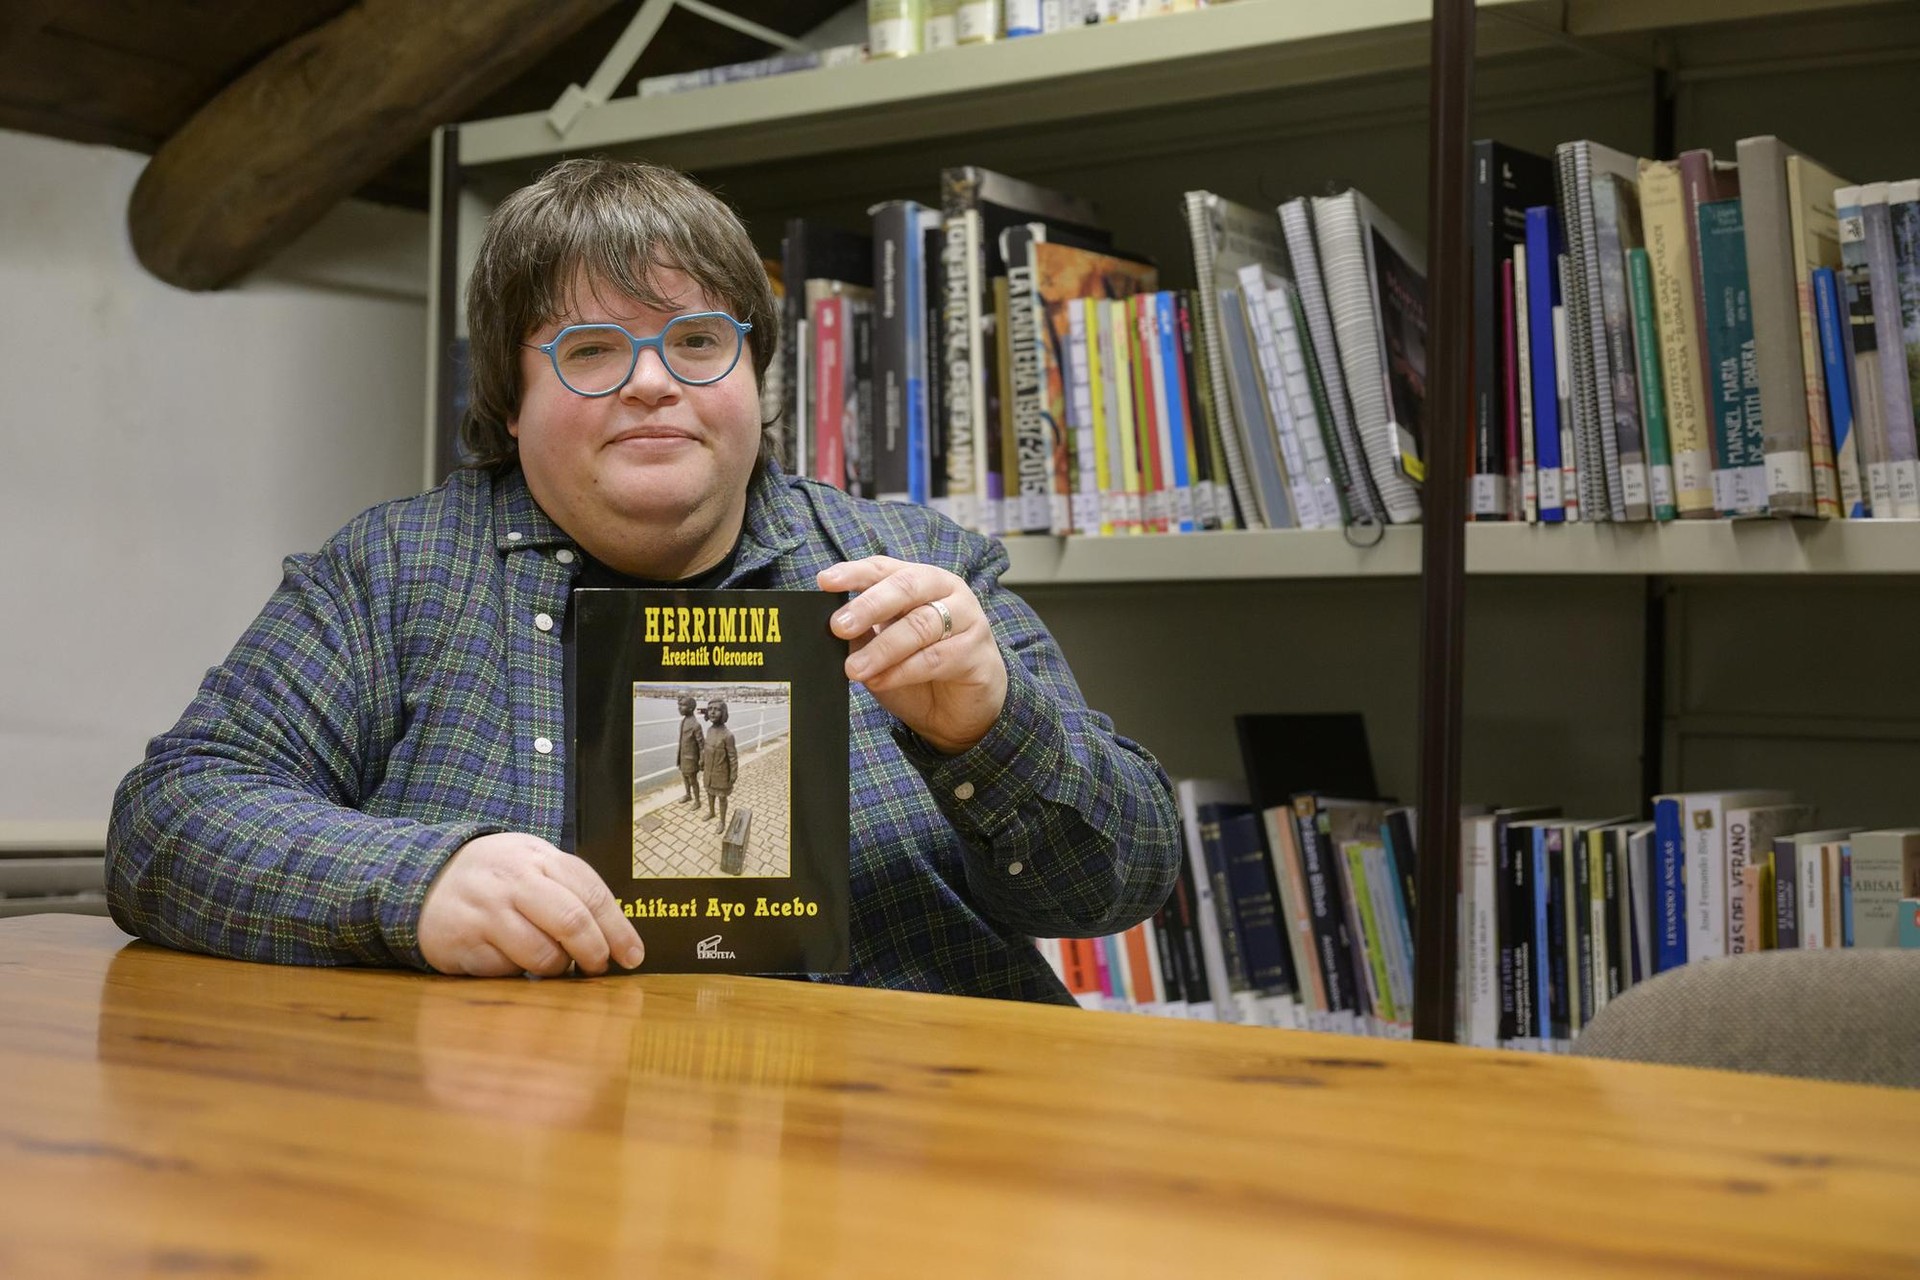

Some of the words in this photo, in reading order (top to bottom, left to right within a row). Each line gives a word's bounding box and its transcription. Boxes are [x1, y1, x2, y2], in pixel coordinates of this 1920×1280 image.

[946, 217, 971, 348] AZUMENDI
[1009, 266, 1033, 295] LA
[948, 357, 976, 495] UNIVERSO
[1724, 404, 1745, 465] MANUEL
[1744, 393, 1763, 438] SMITH
[644, 606, 782, 643] HERRIMINA
[661, 646, 710, 666] Areetatik
[712, 646, 764, 666] Oleronera
[1730, 823, 1745, 888] VERANO
[1853, 879, 1902, 892] ABISAL
[705, 897, 746, 922] Ayo
[754, 897, 818, 918] Acebo
